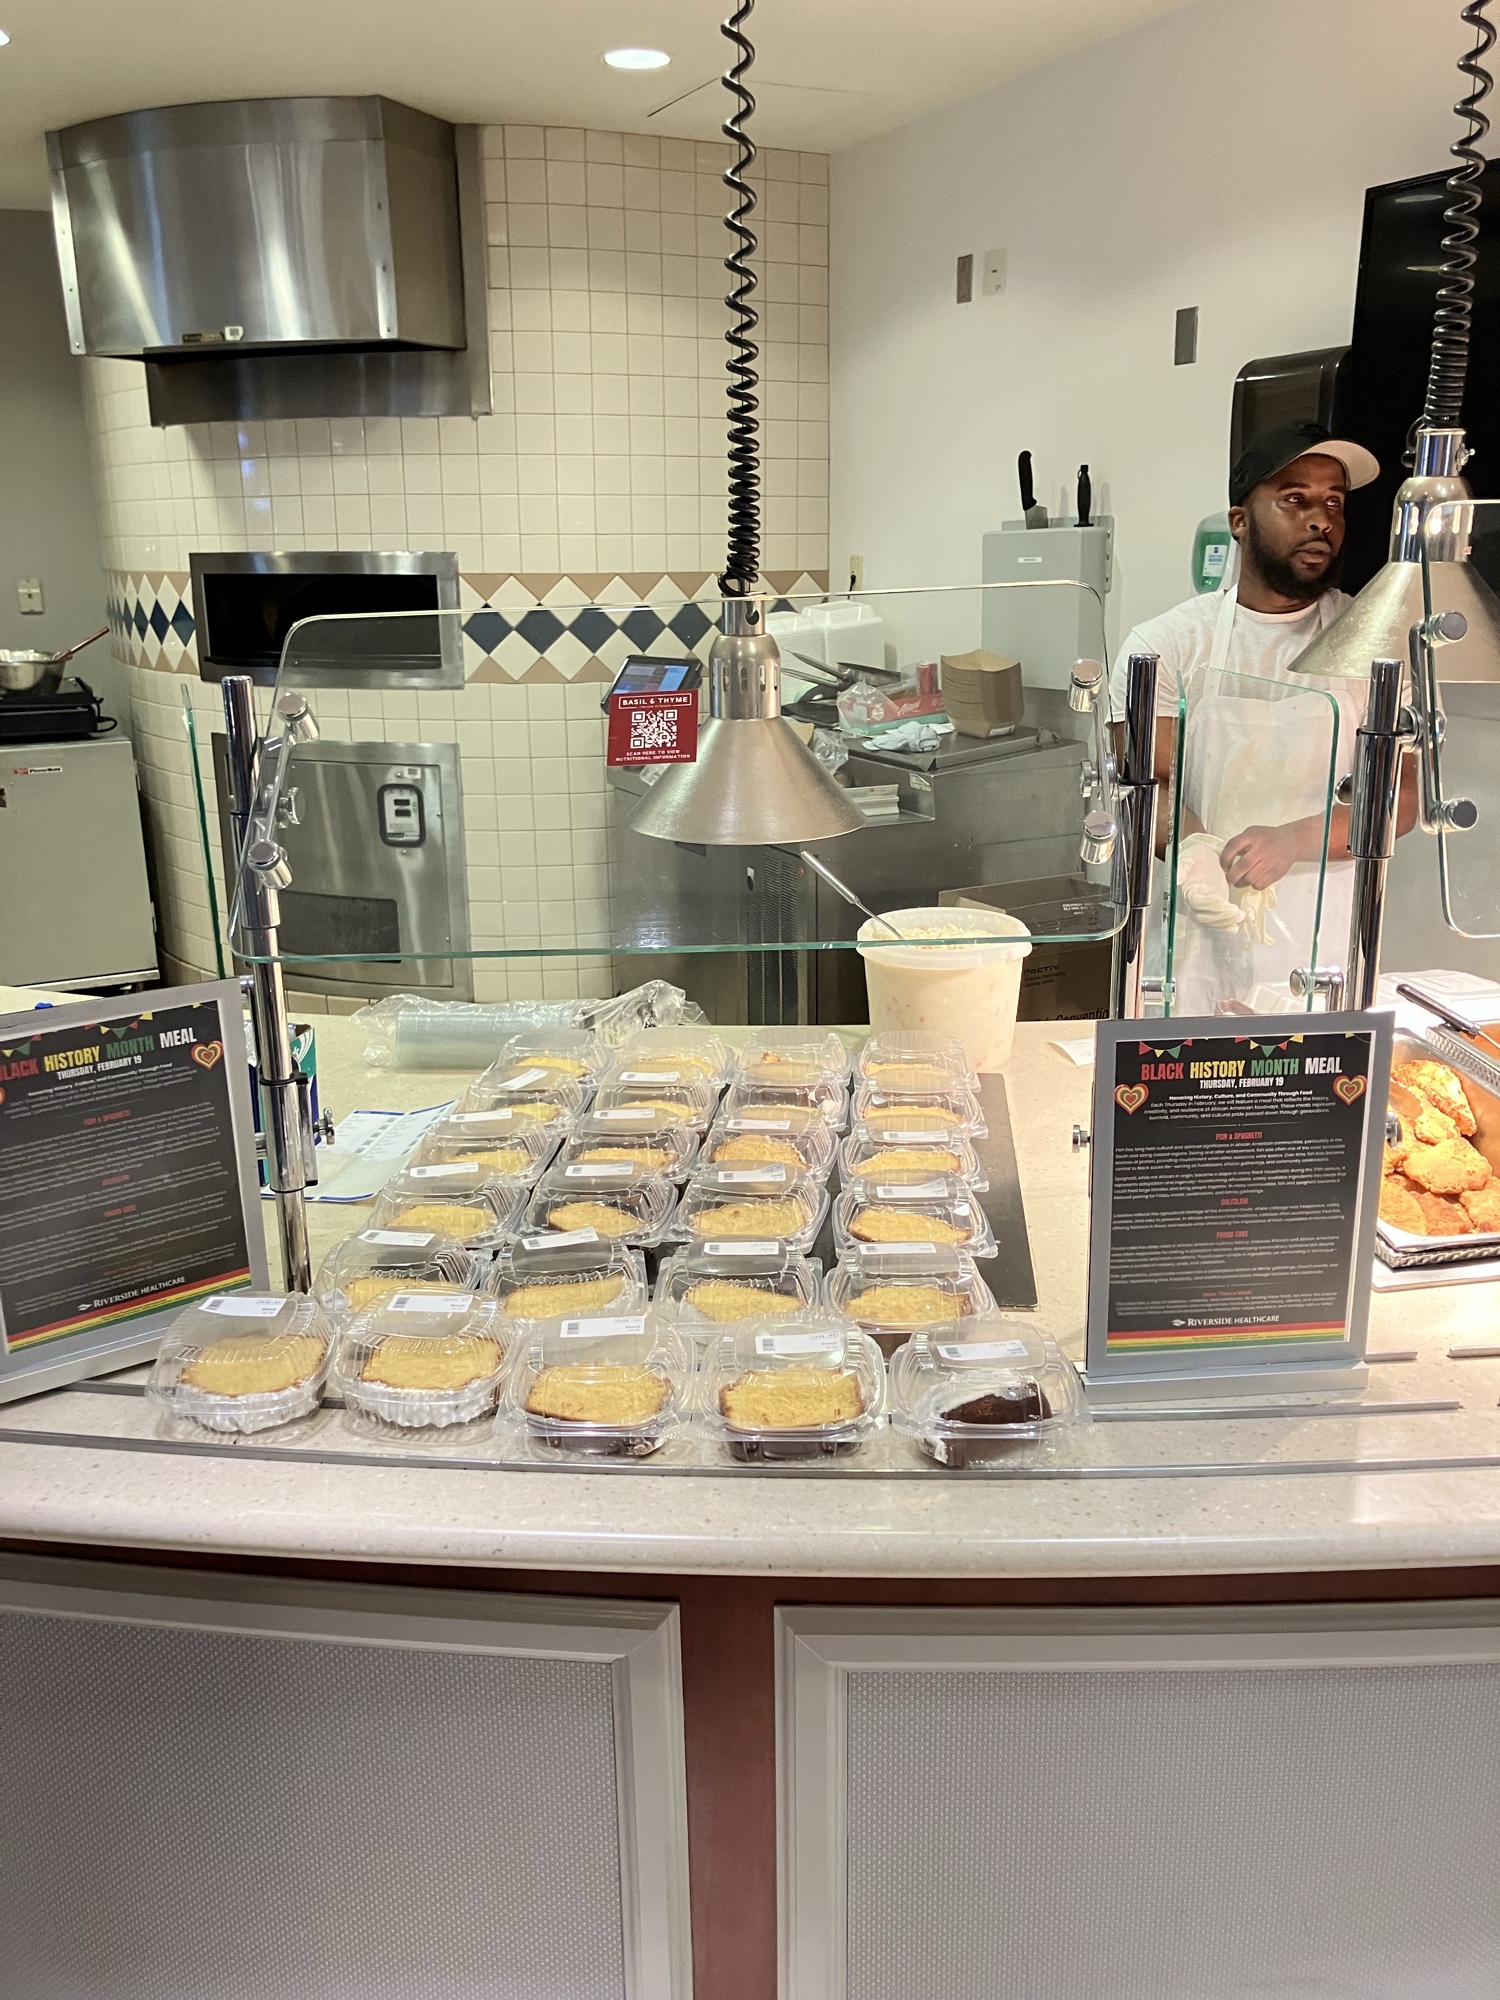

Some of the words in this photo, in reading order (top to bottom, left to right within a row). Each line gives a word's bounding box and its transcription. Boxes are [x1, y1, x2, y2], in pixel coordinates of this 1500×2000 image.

[44, 1046, 100, 1072] HISTORY
[106, 1035, 155, 1059] MONTH
[159, 1027, 197, 1048] MEAL
[57, 1065, 96, 1080] THURSDAY,
[97, 1057, 132, 1071] FEBRUARY
[133, 1055, 142, 1064] 19
[1141, 1063, 1184, 1080] BLACK
[1190, 1060, 1245, 1078] HISTORY
[1251, 1058, 1299, 1076] MONTH
[1305, 1057, 1342, 1074] MEAL
[1200, 1079, 1237, 1089] THURSDAY,
[1239, 1078, 1274, 1087] FEBRUARY
[1276, 1077, 1284, 1086] 19
[94, 1289, 139, 1308] RIVERSIDE
[141, 1276, 185, 1294] HEALTHCARE
[1187, 1318, 1233, 1326] RIVERSIDE
[1234, 1315, 1280, 1324] HEALTHCARE
